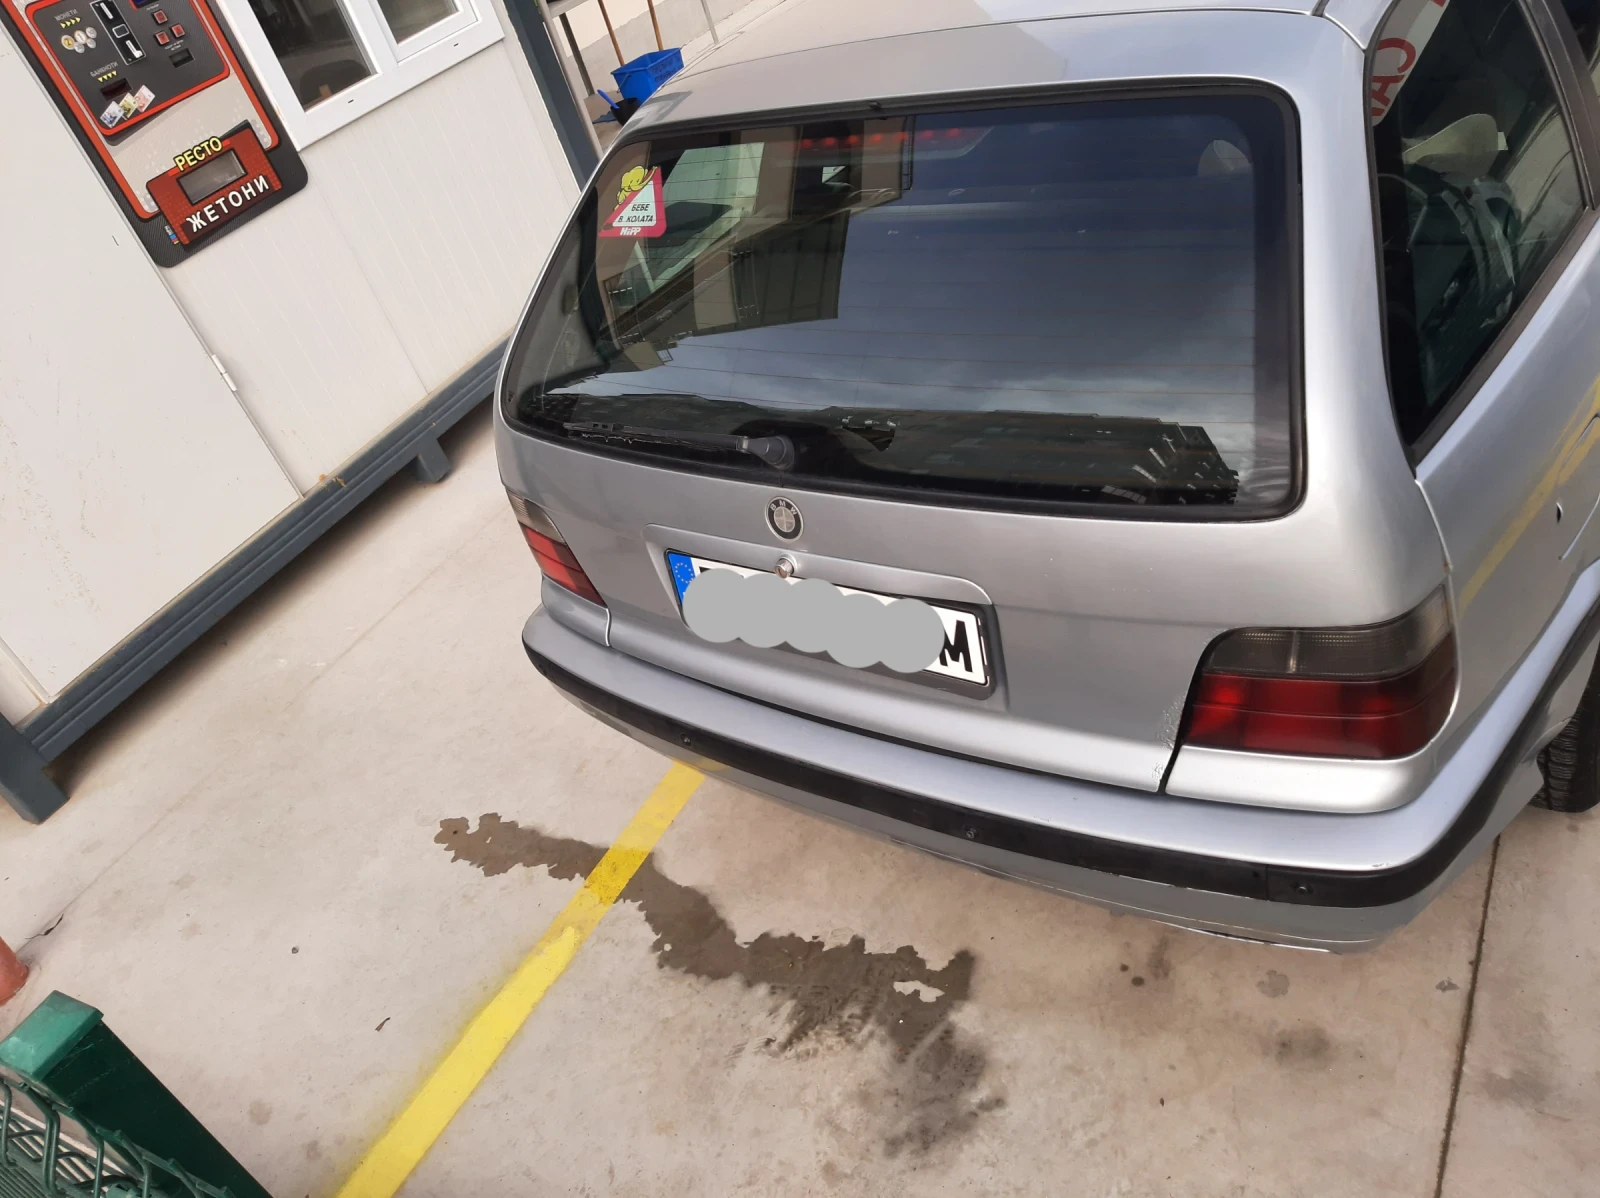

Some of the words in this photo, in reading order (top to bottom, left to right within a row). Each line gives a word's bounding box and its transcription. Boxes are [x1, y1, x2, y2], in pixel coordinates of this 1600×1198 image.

[90, 61, 118, 77] БАНКНОТИ
[175, 137, 222, 171] РЕСТО
[186, 175, 269, 233] ЖЕТОНИ
[770, 500, 798, 515] BMW
